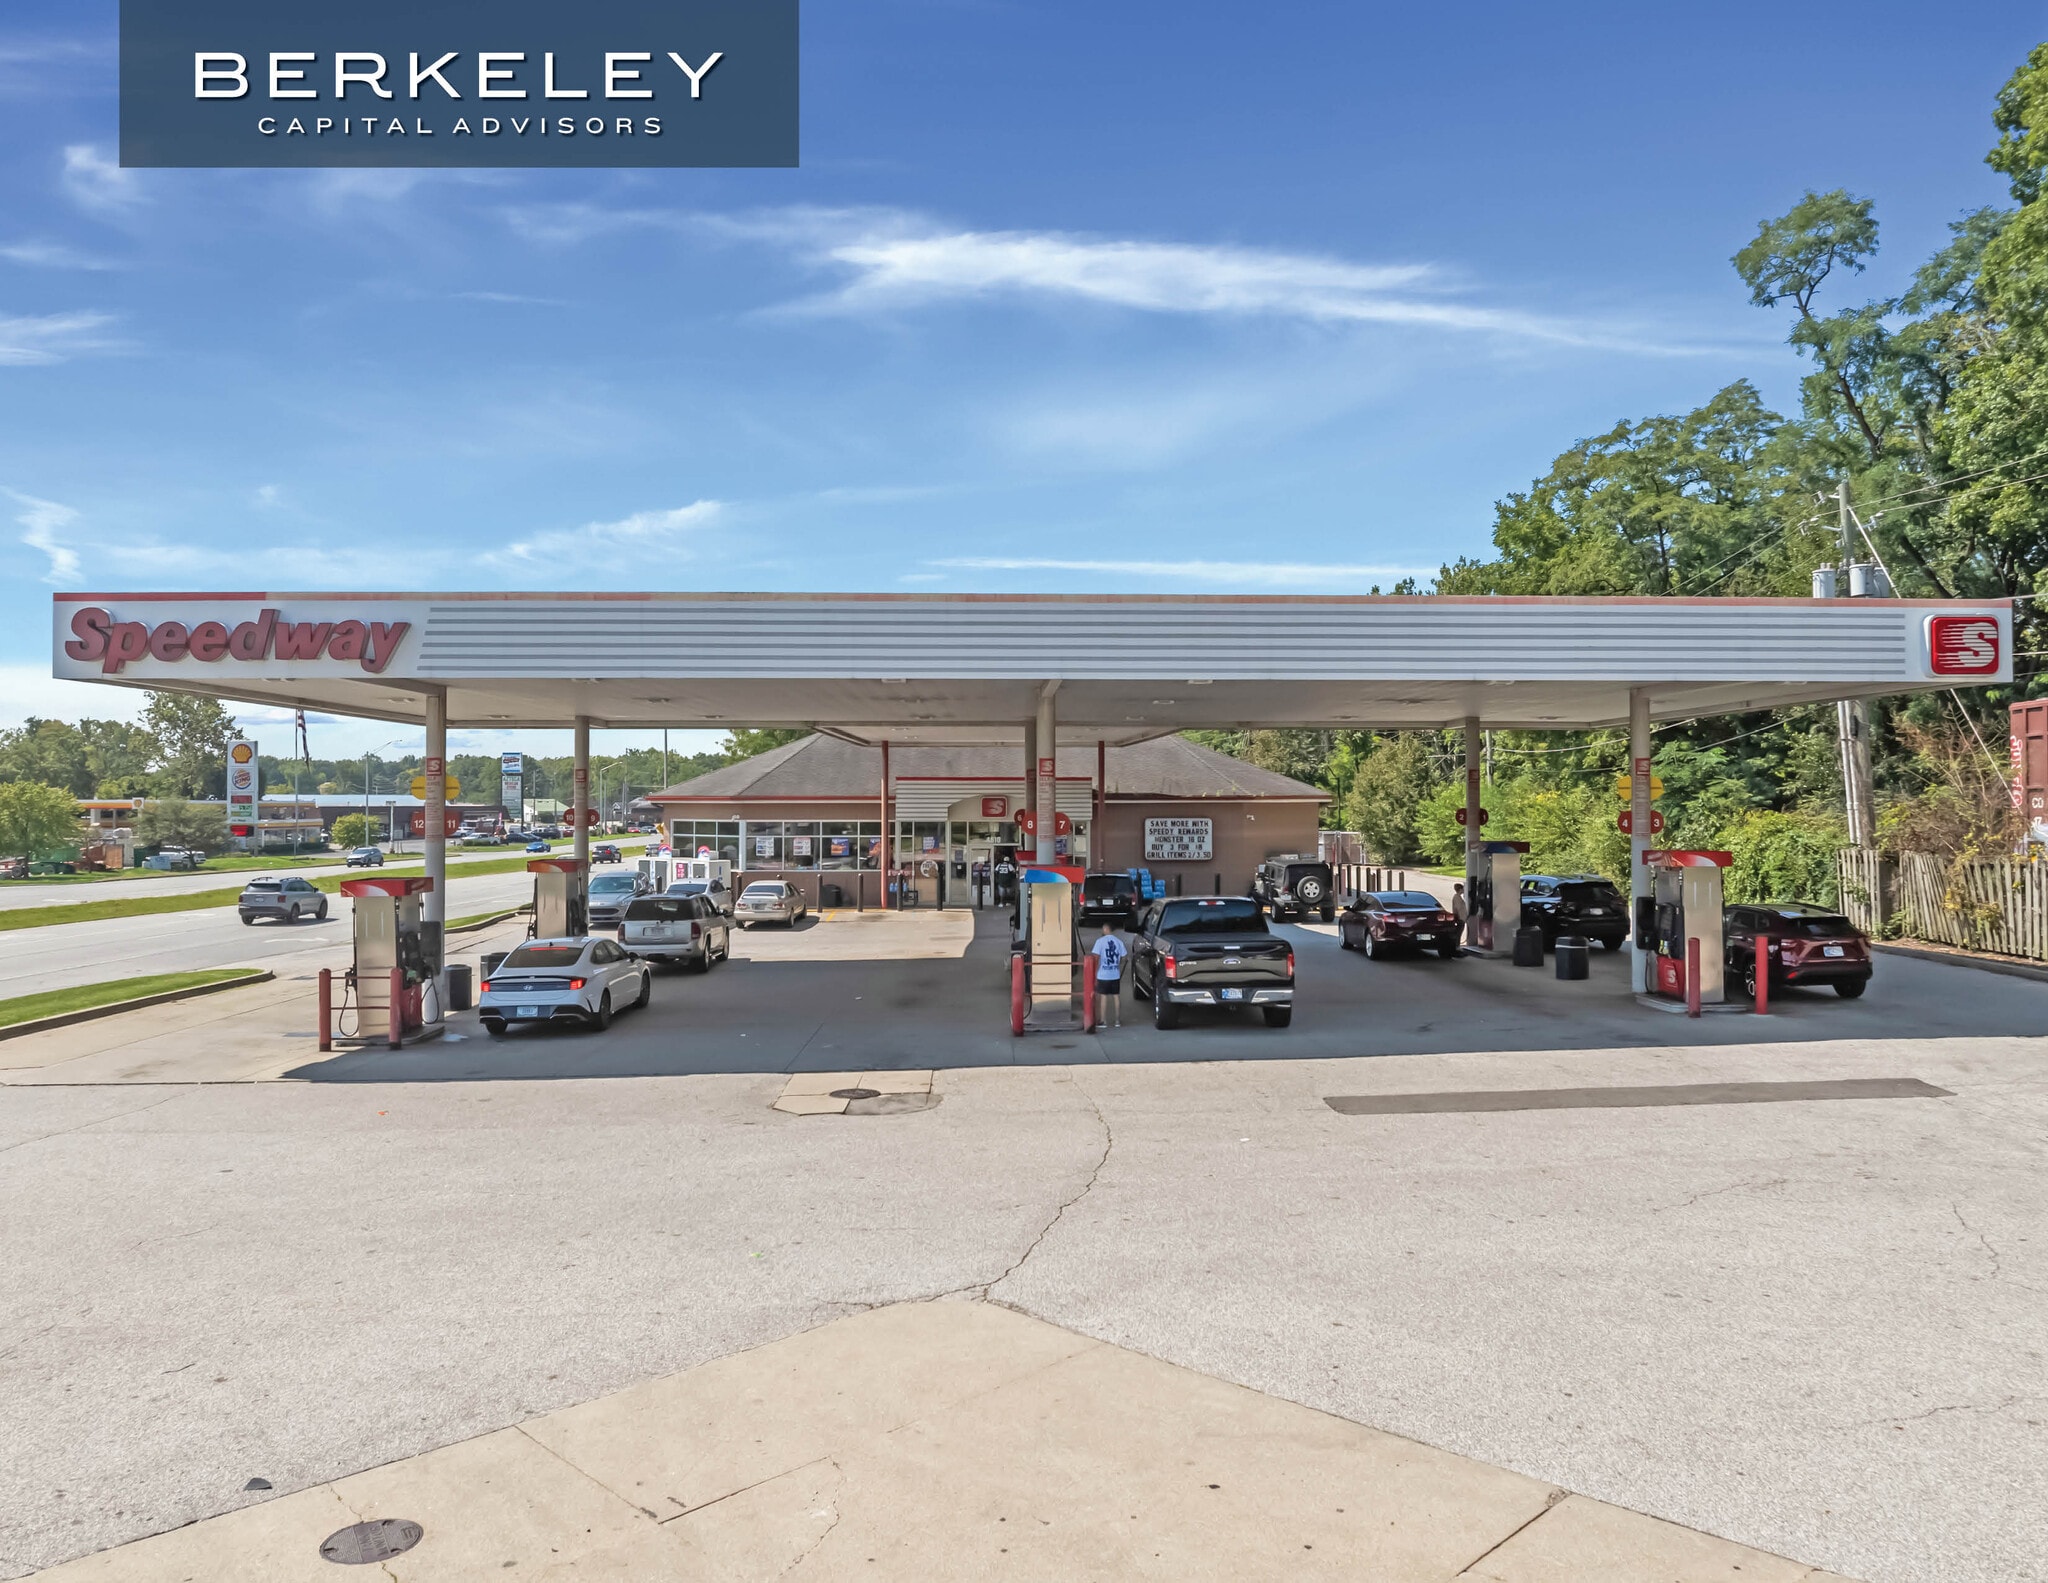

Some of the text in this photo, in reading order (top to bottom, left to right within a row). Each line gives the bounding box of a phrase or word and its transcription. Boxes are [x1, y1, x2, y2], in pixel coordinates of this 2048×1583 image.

[65, 607, 411, 674] Speedway
[566, 814, 574, 822] 10
[590, 814, 596, 822] 9
[1459, 813, 1465, 821] 2
[414, 819, 424, 829] 12
[447, 819, 456, 829] 11
[1027, 820, 1034, 829] 8
[1059, 820, 1066, 830] 7
[1622, 819, 1629, 828] 4
[1653, 818, 1660, 828] 3
